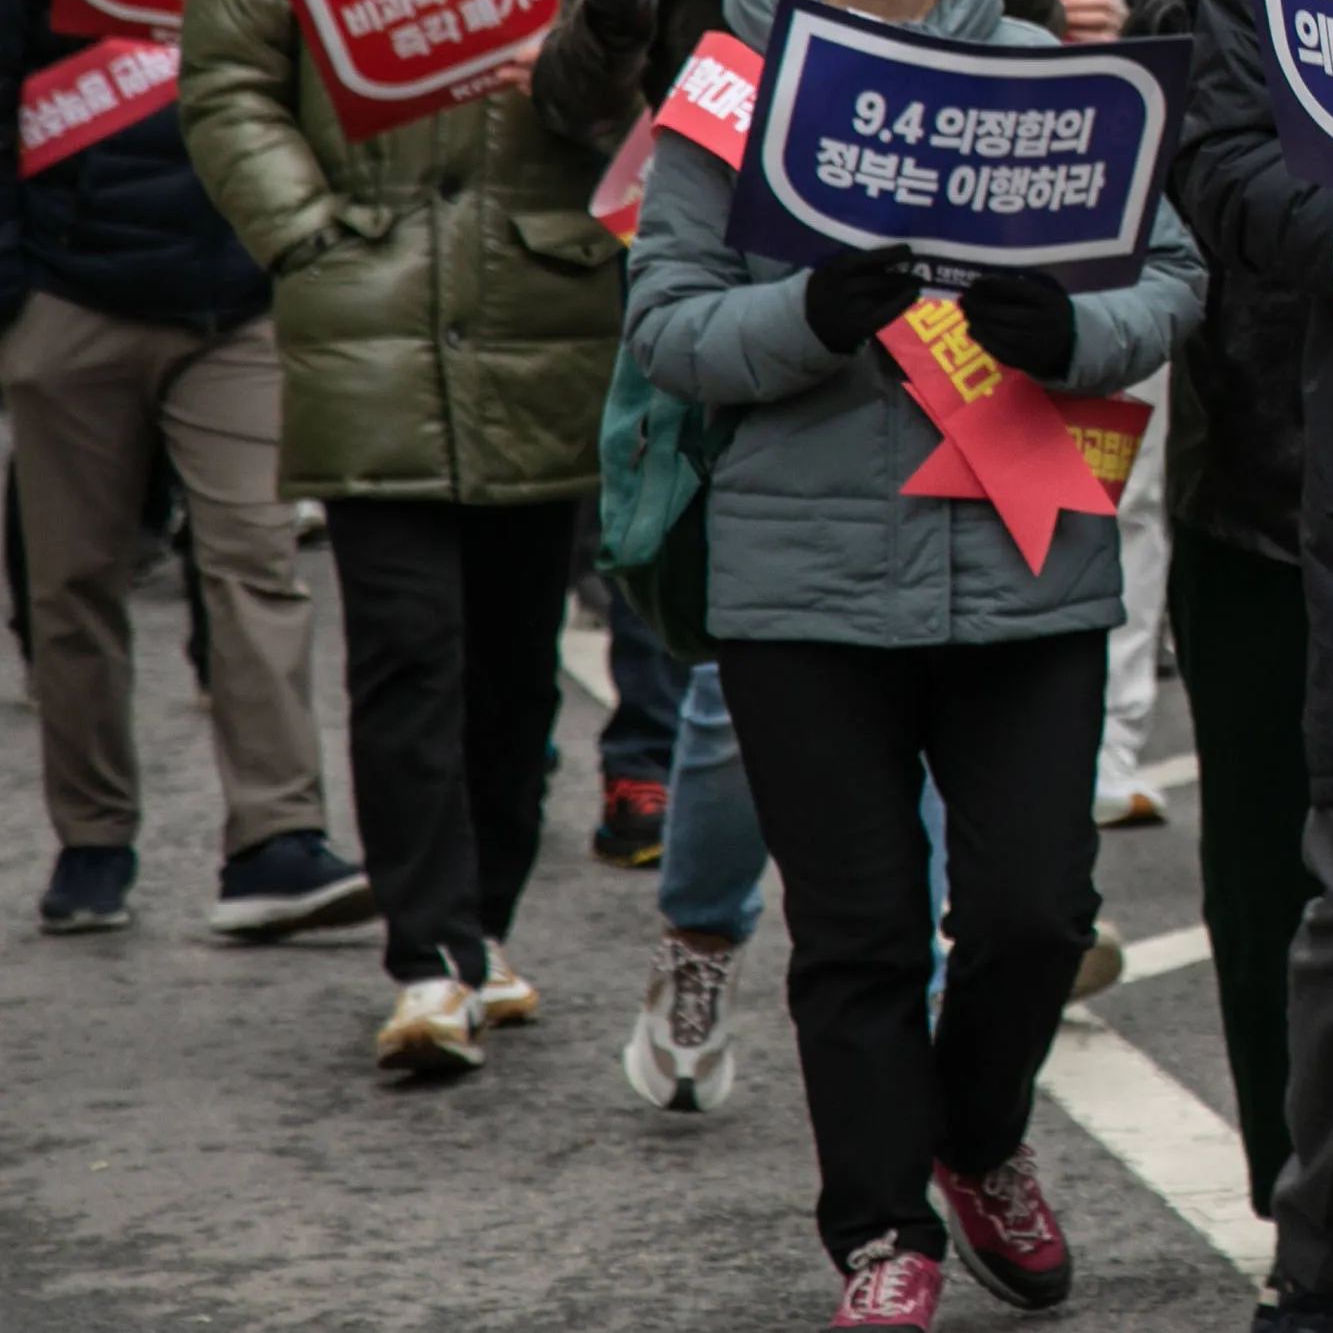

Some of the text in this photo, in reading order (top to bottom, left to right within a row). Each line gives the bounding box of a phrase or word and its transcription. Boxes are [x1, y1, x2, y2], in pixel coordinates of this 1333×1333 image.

[851, 90, 1097, 159] 9.4 의정합의
[815, 137, 1106, 215] 정부는 이행하라
